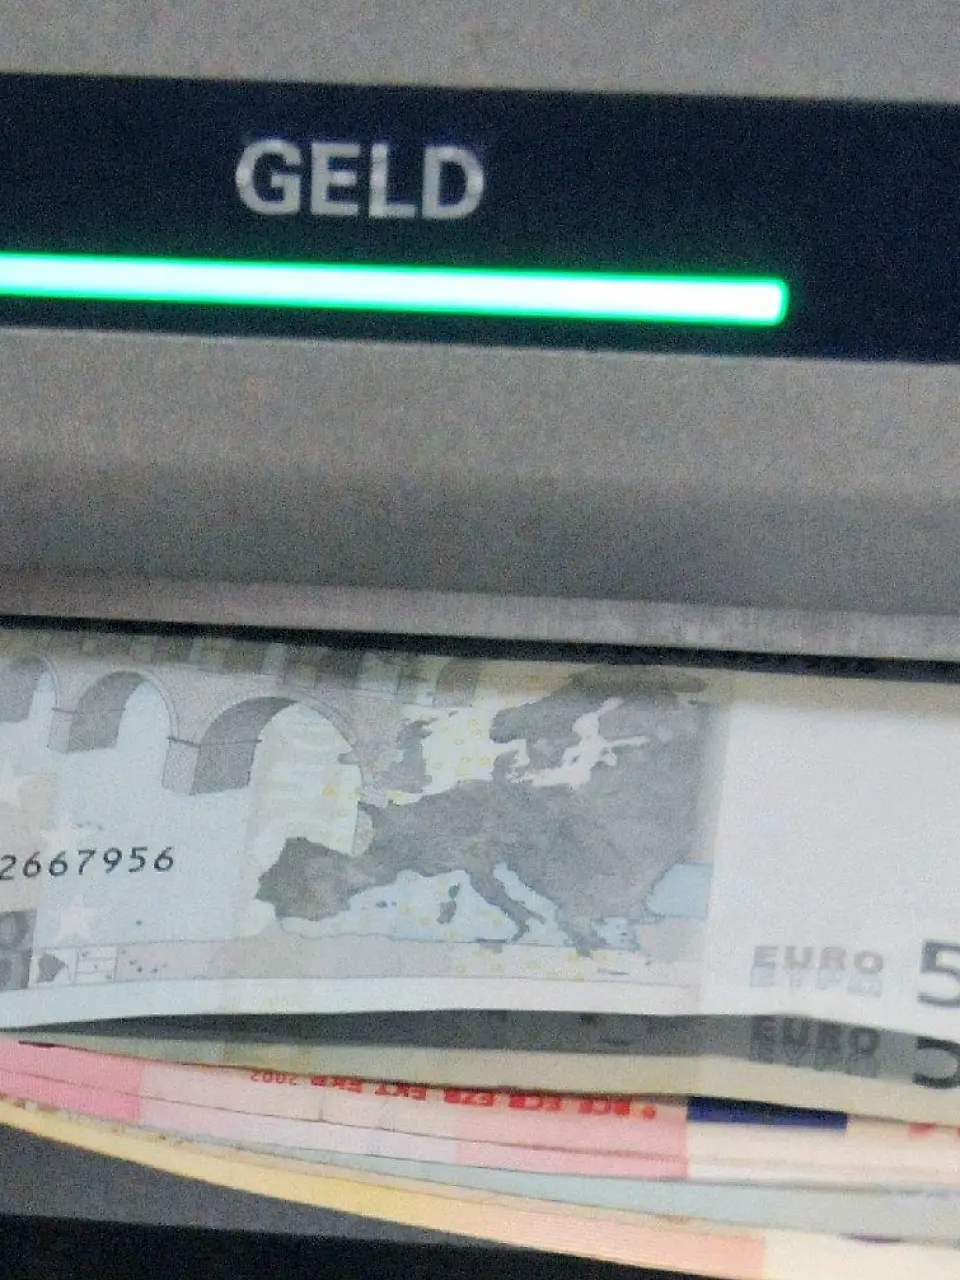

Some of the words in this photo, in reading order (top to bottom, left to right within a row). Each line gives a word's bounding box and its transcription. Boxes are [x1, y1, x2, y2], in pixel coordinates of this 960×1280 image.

[235, 138, 485, 220] GELD
[752, 946, 885, 975] EURO
[916, 940, 960, 1009] 5
